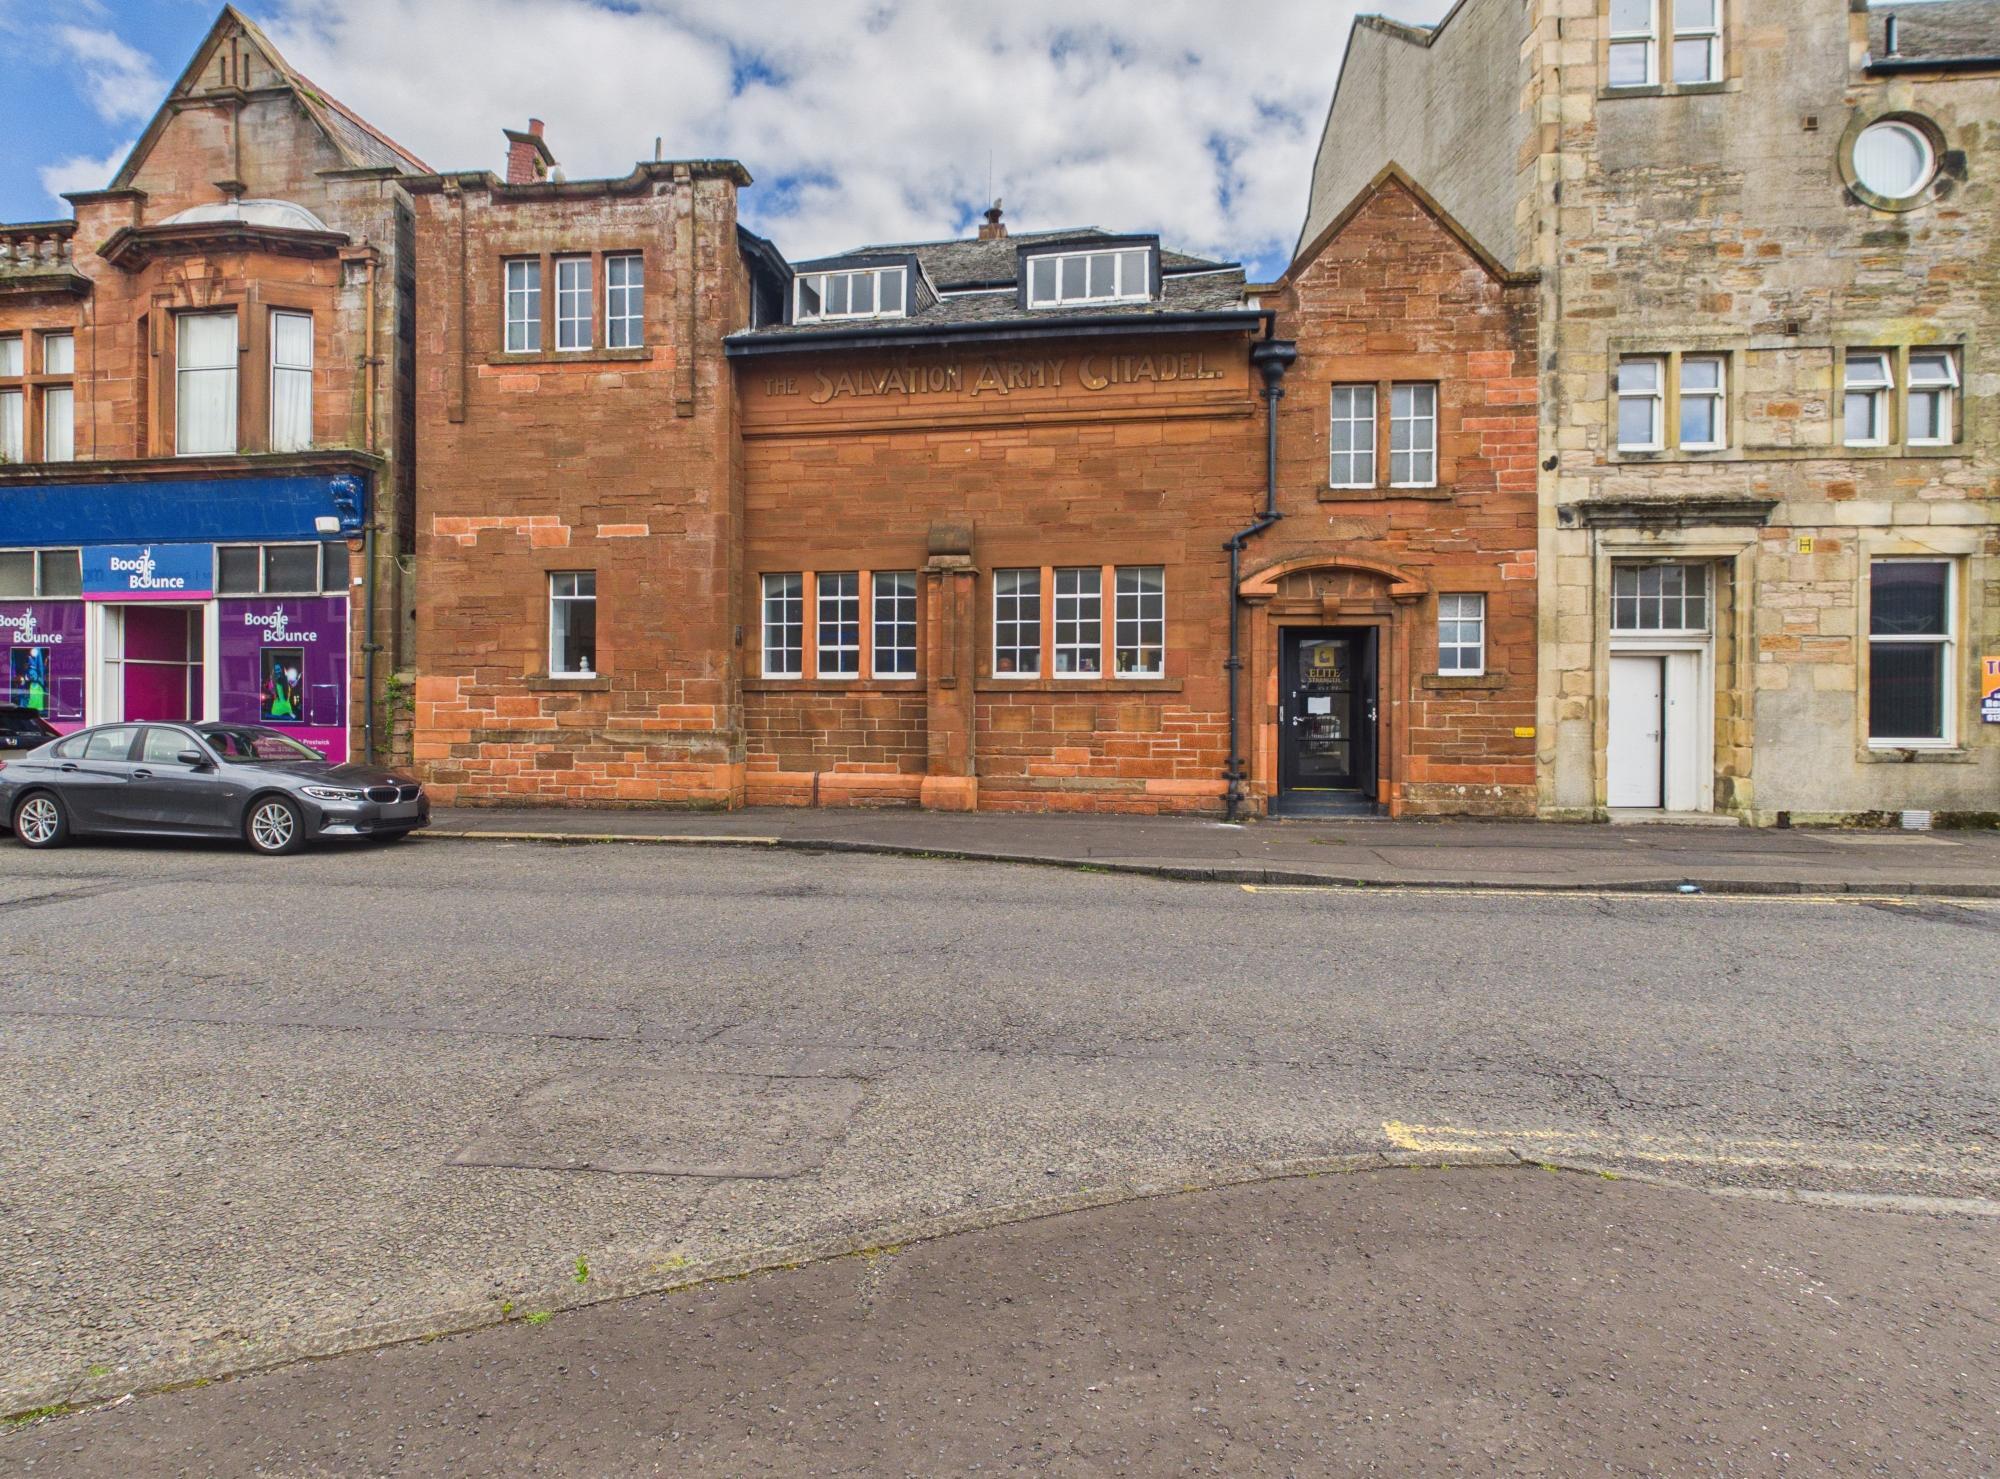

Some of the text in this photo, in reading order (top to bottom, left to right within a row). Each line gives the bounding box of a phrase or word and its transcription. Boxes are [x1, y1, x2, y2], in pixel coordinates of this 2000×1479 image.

[764, 376, 800, 396] THE
[809, 364, 963, 404] SALVATION
[970, 357, 1066, 396] ARMY
[1800, 538, 1811, 552] H
[110, 557, 156, 574] Boogie
[129, 574, 184, 588] Bounce
[244, 613, 289, 628] Boogie
[13, 631, 63, 644] Bounce
[263, 629, 317, 642] Bounce
